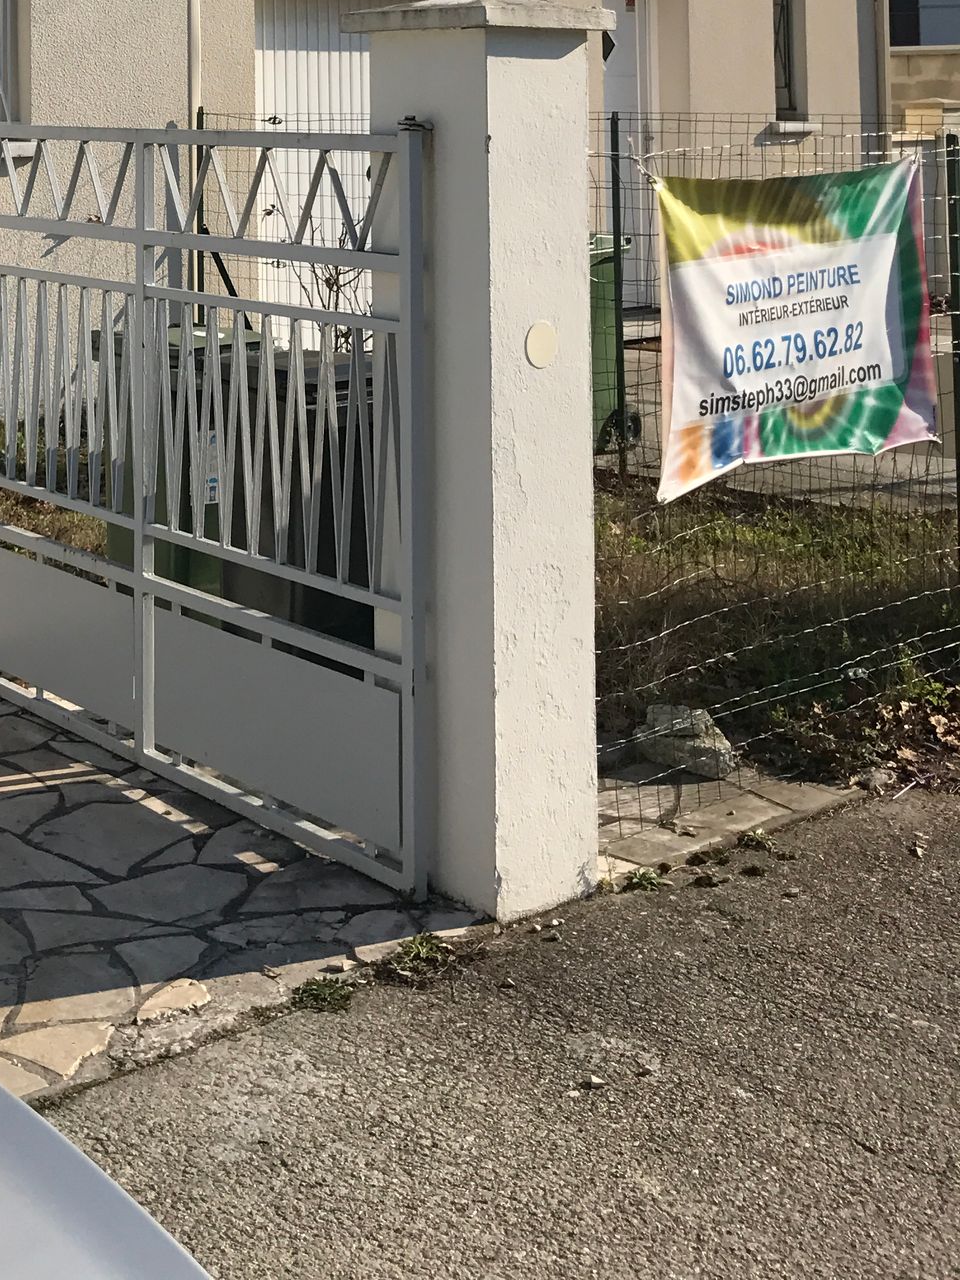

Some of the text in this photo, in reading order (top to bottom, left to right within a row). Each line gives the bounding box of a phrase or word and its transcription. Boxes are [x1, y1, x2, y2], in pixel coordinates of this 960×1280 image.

[726, 264, 860, 305] SIMOND PEINTURE
[739, 295, 849, 326] INTÉRIEUR-EXTÉRIEUR
[724, 321, 864, 378] 06.62.79.62.82
[700, 363, 882, 416] simsteph33@gmail.com
